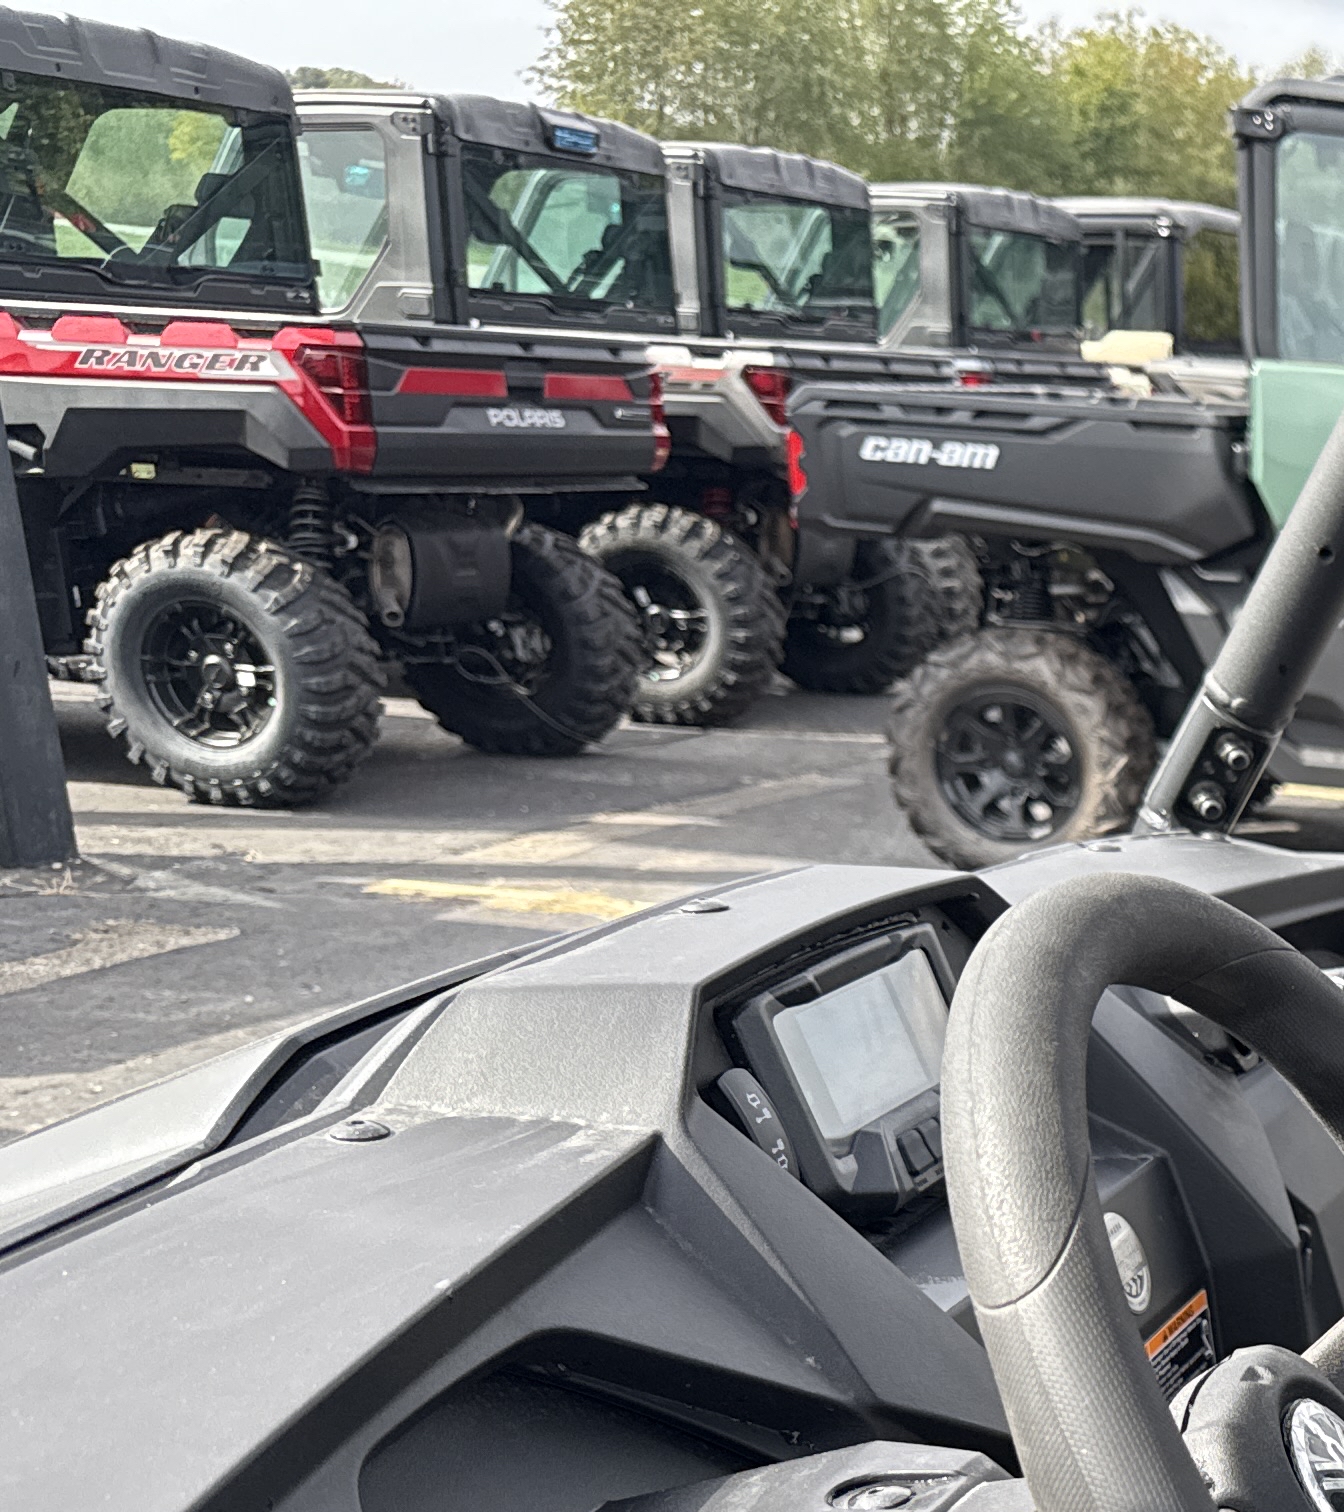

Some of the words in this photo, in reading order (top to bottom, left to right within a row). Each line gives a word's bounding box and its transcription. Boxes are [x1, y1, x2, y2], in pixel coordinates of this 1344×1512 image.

[76, 347, 269, 373] RANGER
[486, 406, 566, 429] POLARIS
[858, 434, 1001, 470] can-am
